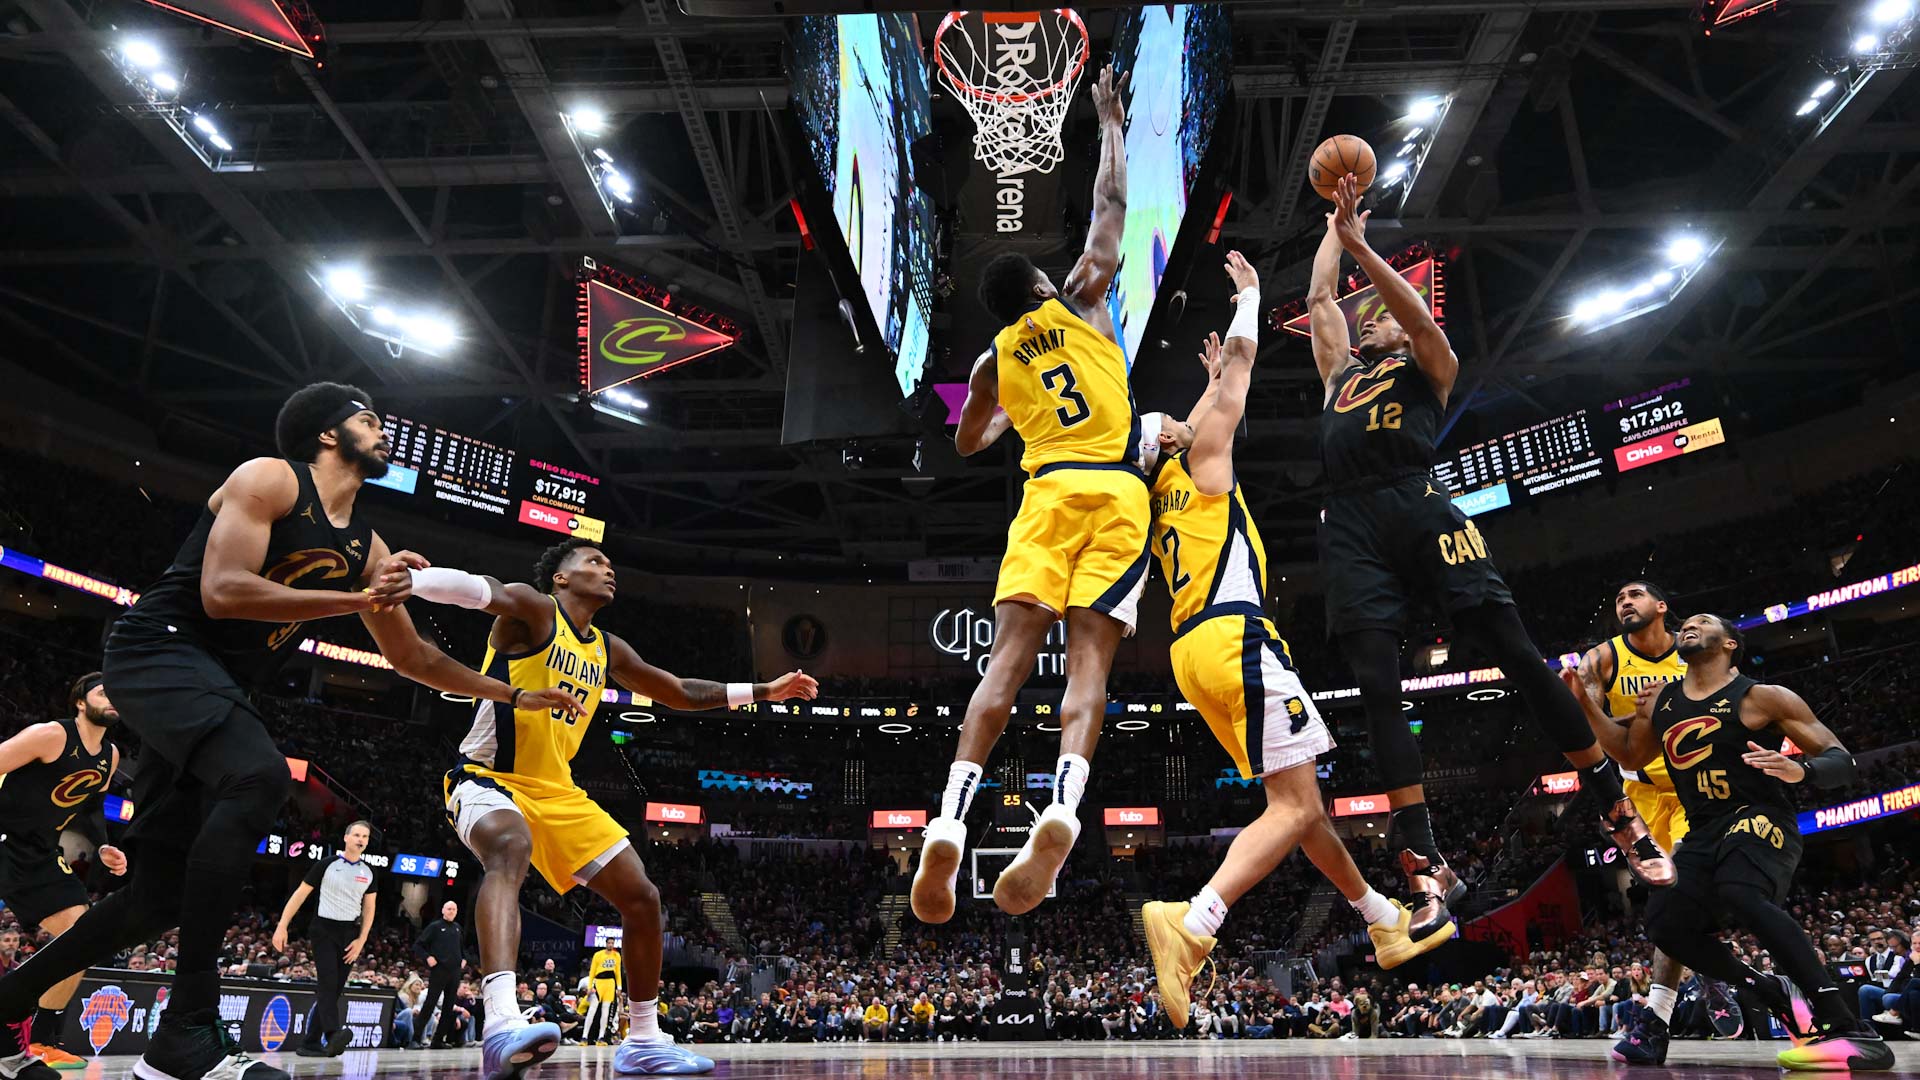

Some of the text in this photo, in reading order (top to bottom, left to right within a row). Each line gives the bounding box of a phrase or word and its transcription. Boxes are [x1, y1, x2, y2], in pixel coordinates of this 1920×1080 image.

[996, 157, 1037, 233] Arena
[1013, 328, 1066, 366] BRYANT
[1040, 362, 1091, 429] 3
[1366, 402, 1404, 432] 12
[1619, 401, 1684, 433] $17,912
[1622, 417, 1689, 443] CAVS.COM/RAFFLE
[1626, 449, 1663, 467] Ohio
[560, 468, 600, 485] RAFFLE
[1529, 480, 1565, 495] BENNEDICT
[436, 490, 471, 506] BENNEDICT
[535, 478, 587, 504] $17,912
[532, 494, 585, 514] CAVS.COM/RAFFLE
[529, 508, 559, 525] Ohio
[1438, 519, 1488, 566] CAV
[1162, 525, 1191, 596] 2
[42, 562, 118, 600] FIREWORKS
[1807, 575, 1889, 611] PHANTOM
[1401, 671, 1466, 694] PHANTOM
[792, 705, 800, 715] 2
[811, 706, 839, 716] FOULS
[843, 707, 850, 717] 5
[884, 707, 897, 717] 39
[936, 706, 950, 717] 74
[1035, 704, 1051, 714] 3Q
[1150, 704, 1162, 713] 49
[1547, 777, 1574, 790] fubo
[1696, 770, 1731, 800] 45
[661, 806, 686, 819] fubo
[1119, 811, 1143, 824] fubo
[1350, 800, 1374, 812] fubo
[1815, 798, 1881, 828] PHANTOM
[888, 814, 912, 825] fubo
[308, 844, 324, 860] 31
[400, 857, 416, 872] 35
[1005, 988, 1027, 998] Google
[82, 993, 127, 1022] KNICKS
[997, 1014, 1034, 1024] KIA
[132, 1008, 147, 1032] VS
[294, 1013, 304, 1034] VS
